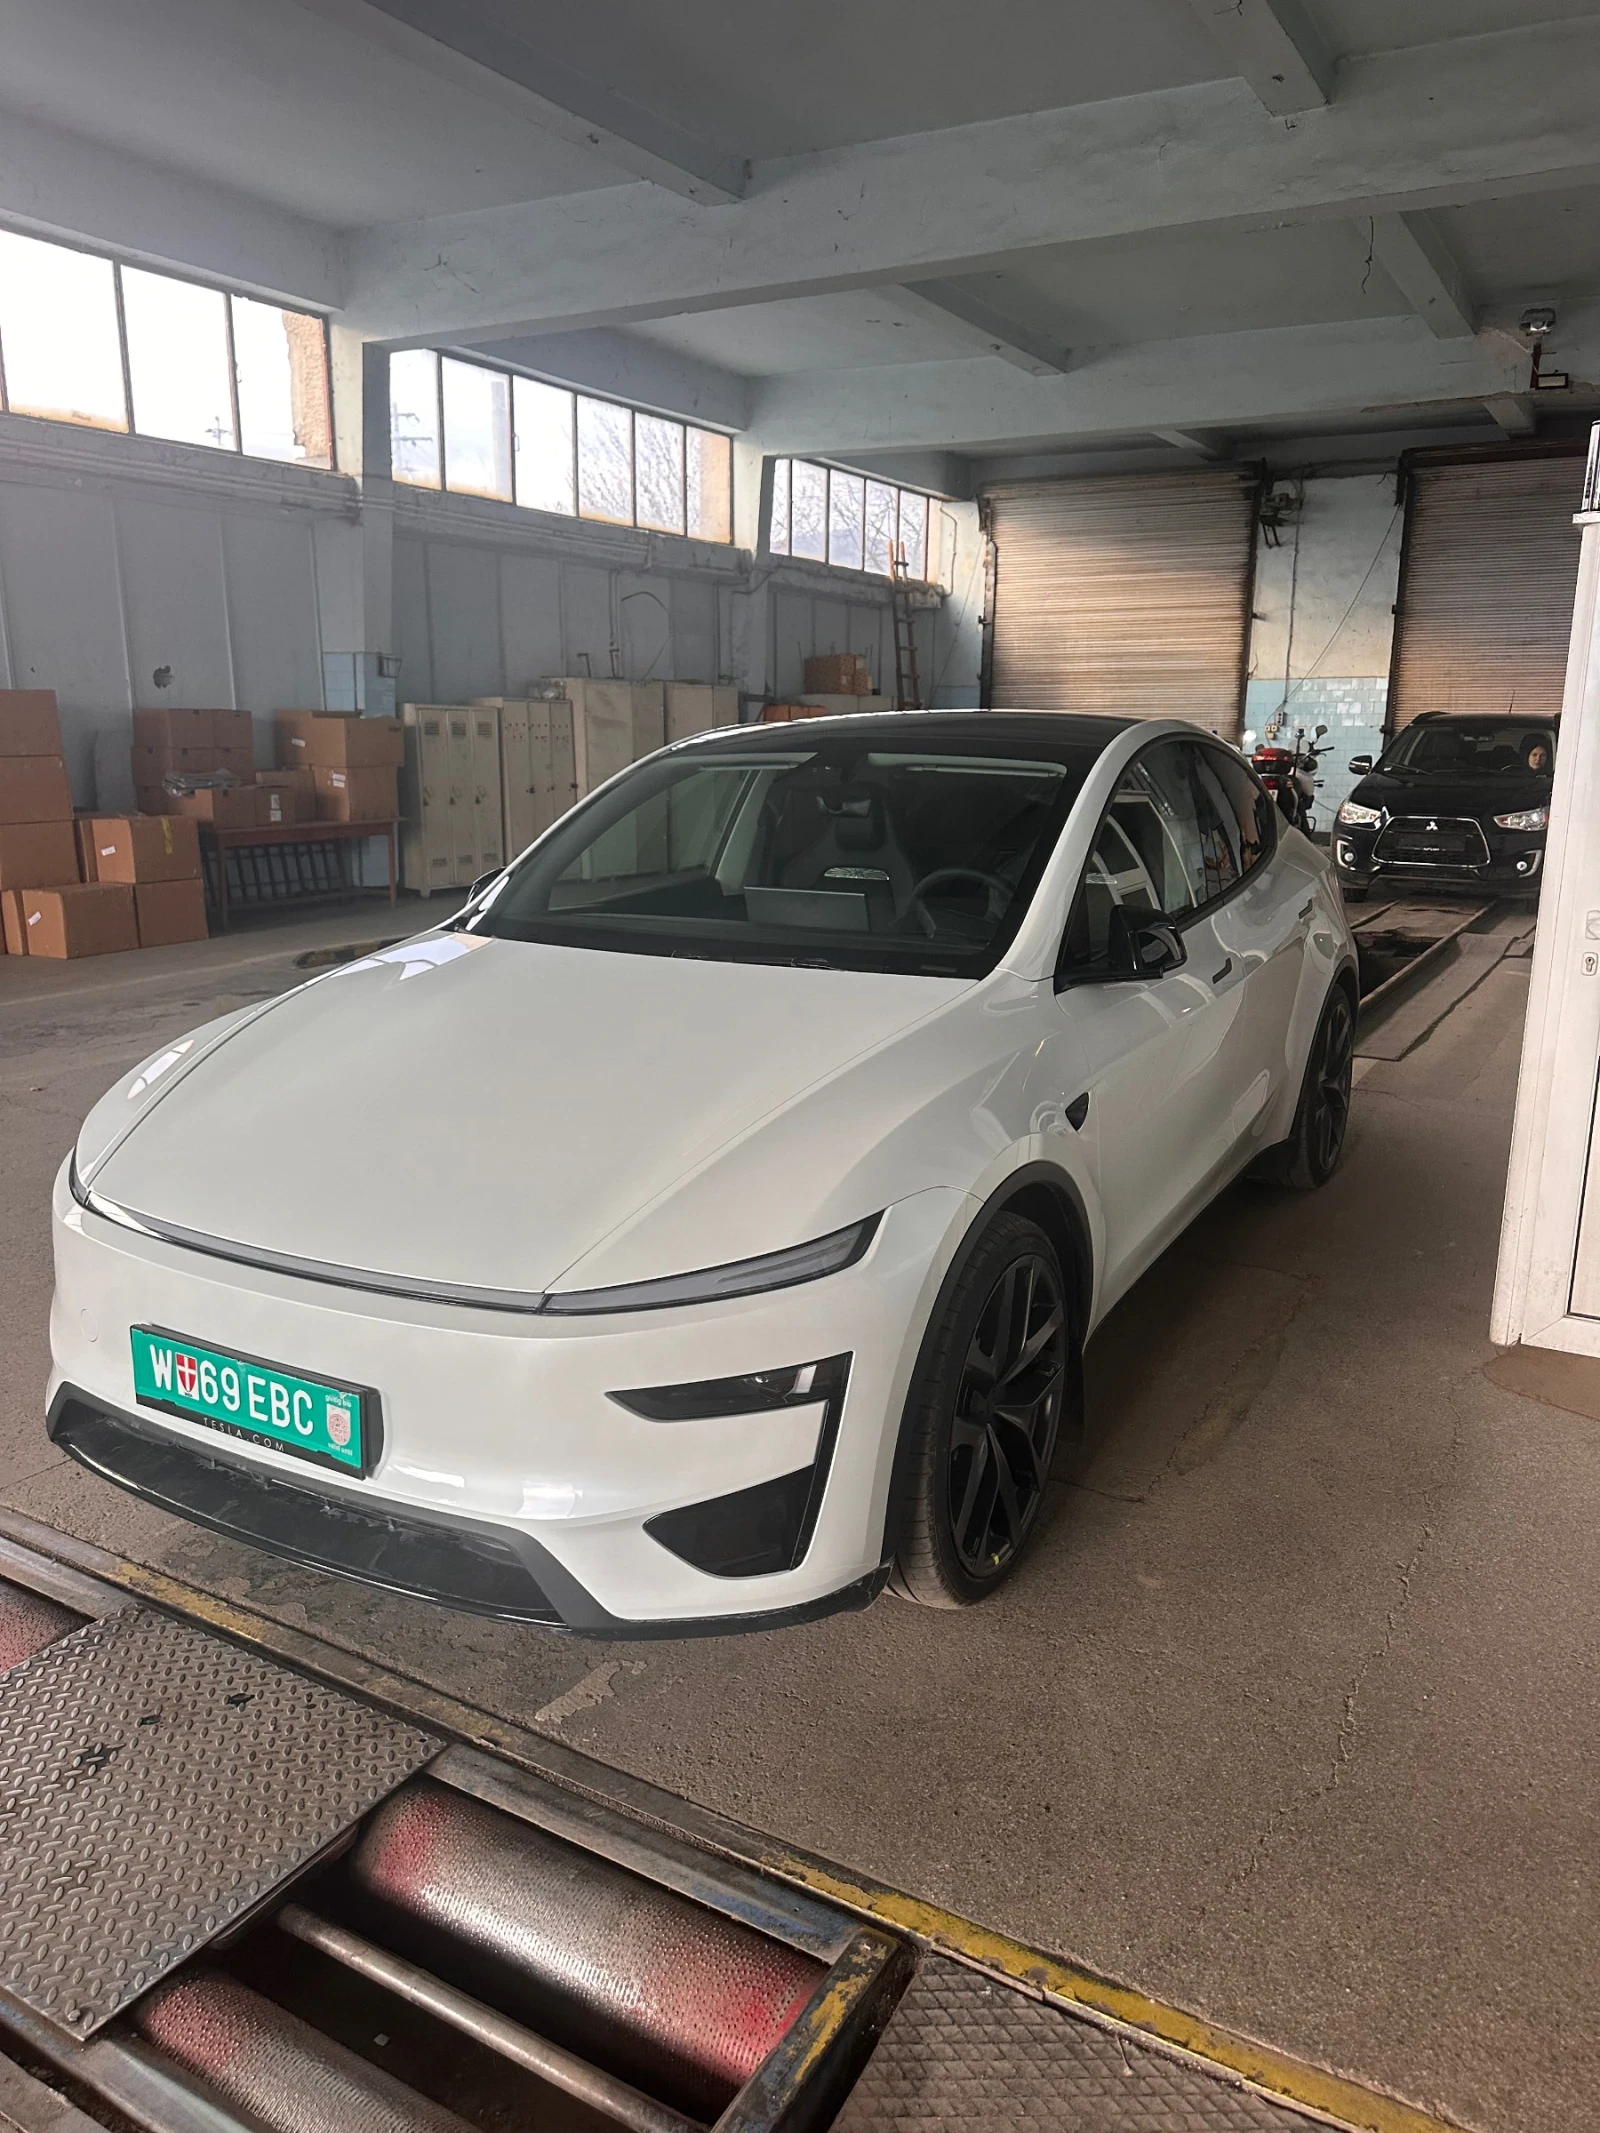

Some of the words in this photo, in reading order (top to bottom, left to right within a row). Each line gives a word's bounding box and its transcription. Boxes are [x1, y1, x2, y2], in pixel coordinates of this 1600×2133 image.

[150, 1344, 172, 1391] W
[200, 1360, 240, 1411] 69
[247, 1374, 313, 1436] EBC
[203, 1417, 285, 1452] TESLA.COM
